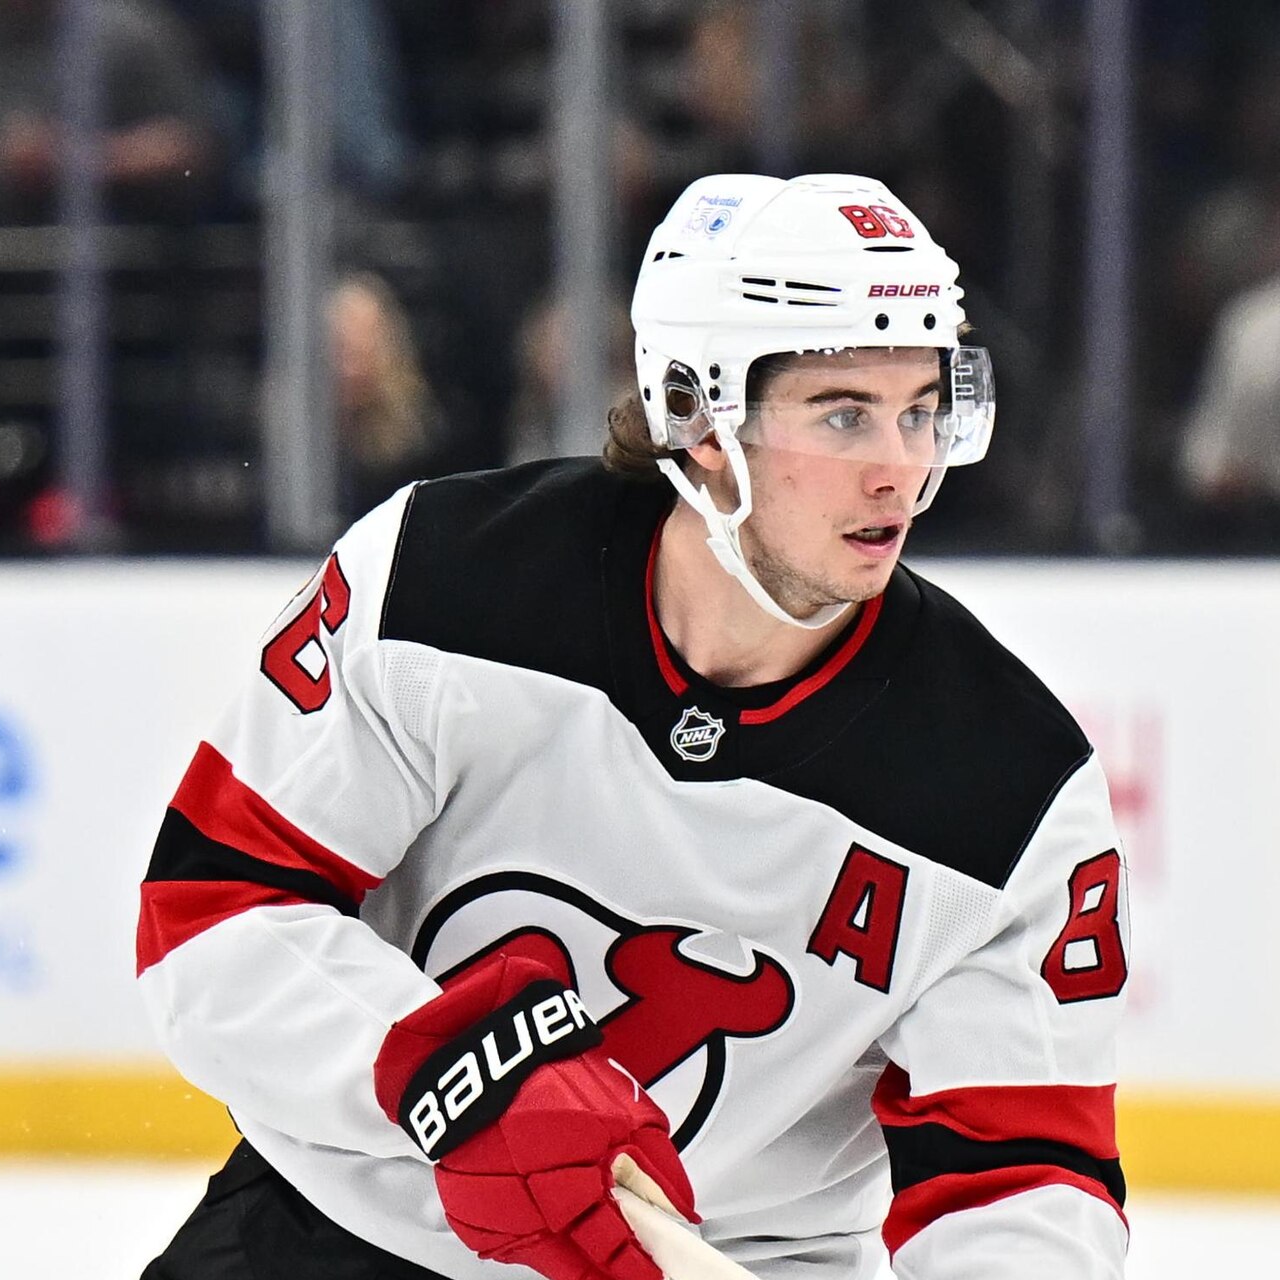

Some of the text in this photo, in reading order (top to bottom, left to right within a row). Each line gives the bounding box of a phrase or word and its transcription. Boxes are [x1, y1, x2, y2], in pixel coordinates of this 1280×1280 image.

[838, 205, 915, 239] 86
[260, 551, 351, 714] 6
[680, 729, 713, 743] NHL
[807, 842, 910, 994] A
[1040, 848, 1129, 1005] 8
